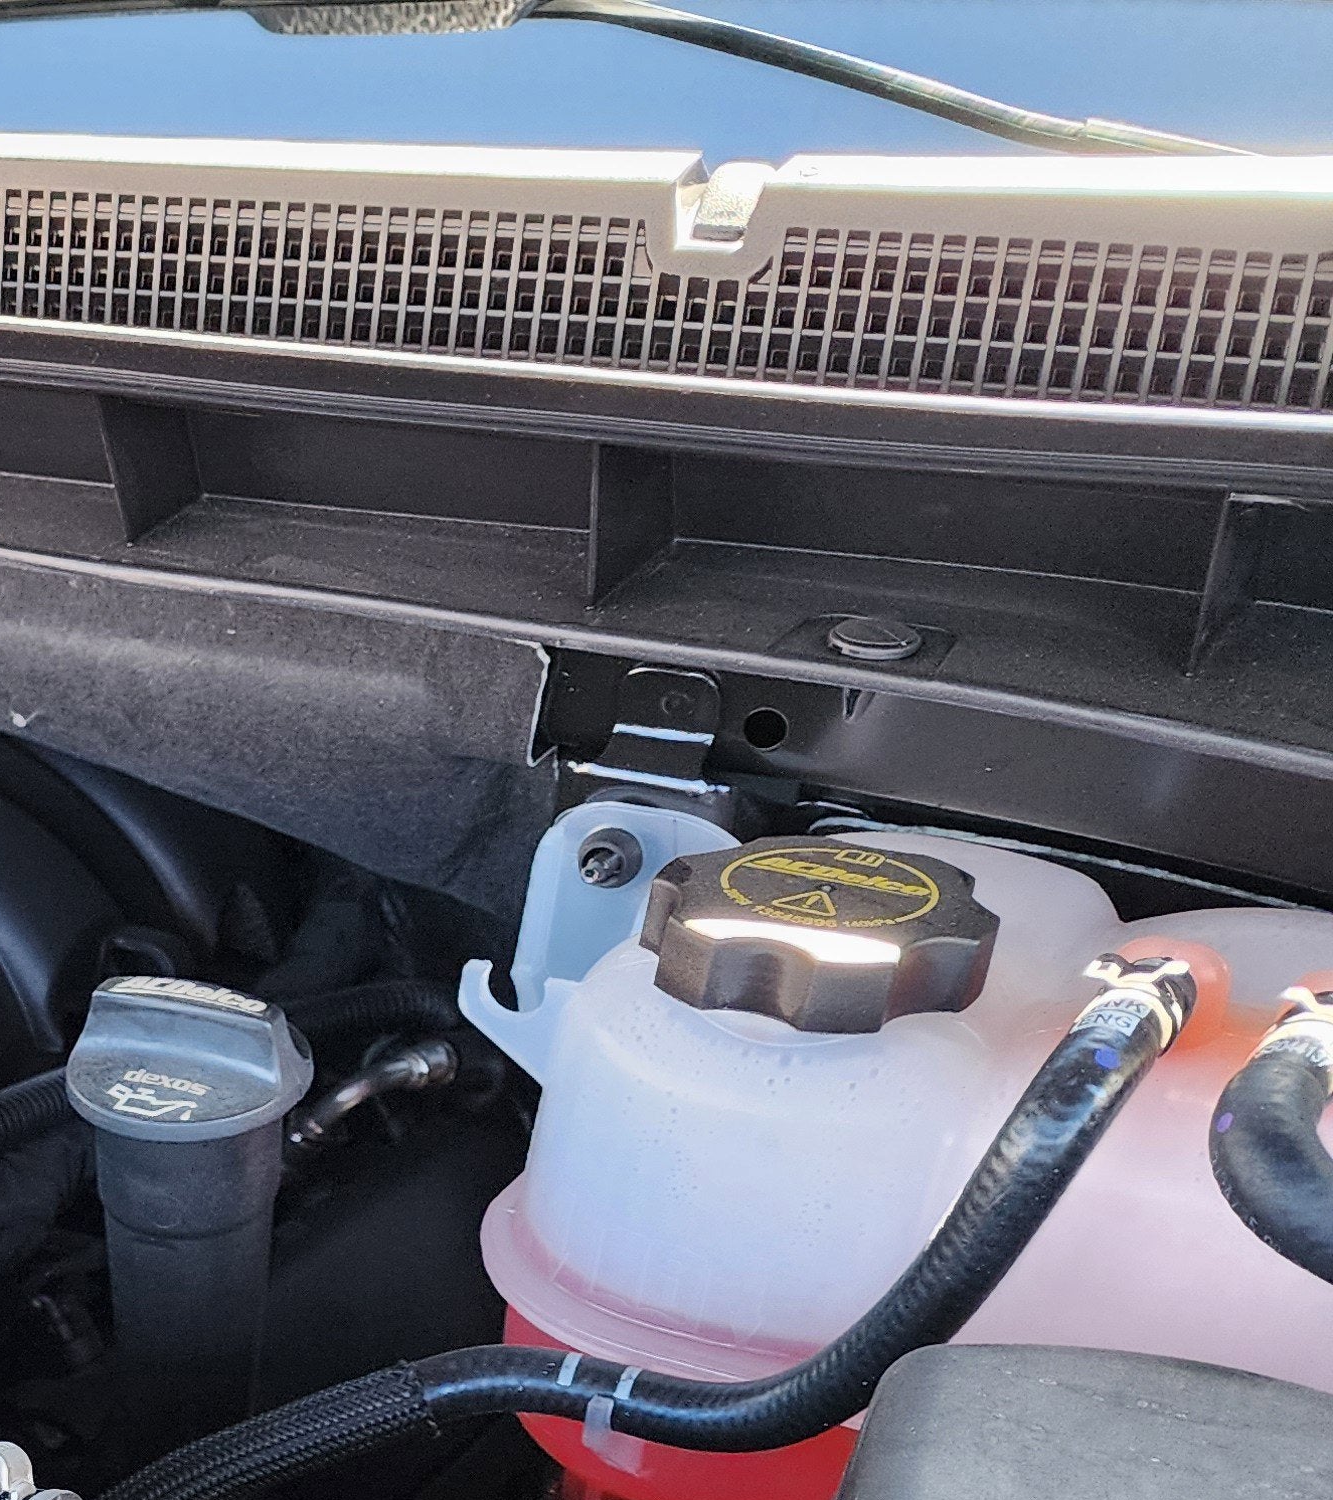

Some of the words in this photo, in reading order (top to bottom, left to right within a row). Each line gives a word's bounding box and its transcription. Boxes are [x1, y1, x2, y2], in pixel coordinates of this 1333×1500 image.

[751, 857, 931, 897] ACDelco
[111, 976, 268, 1013] ACDelco
[123, 1068, 212, 1096] dexos
